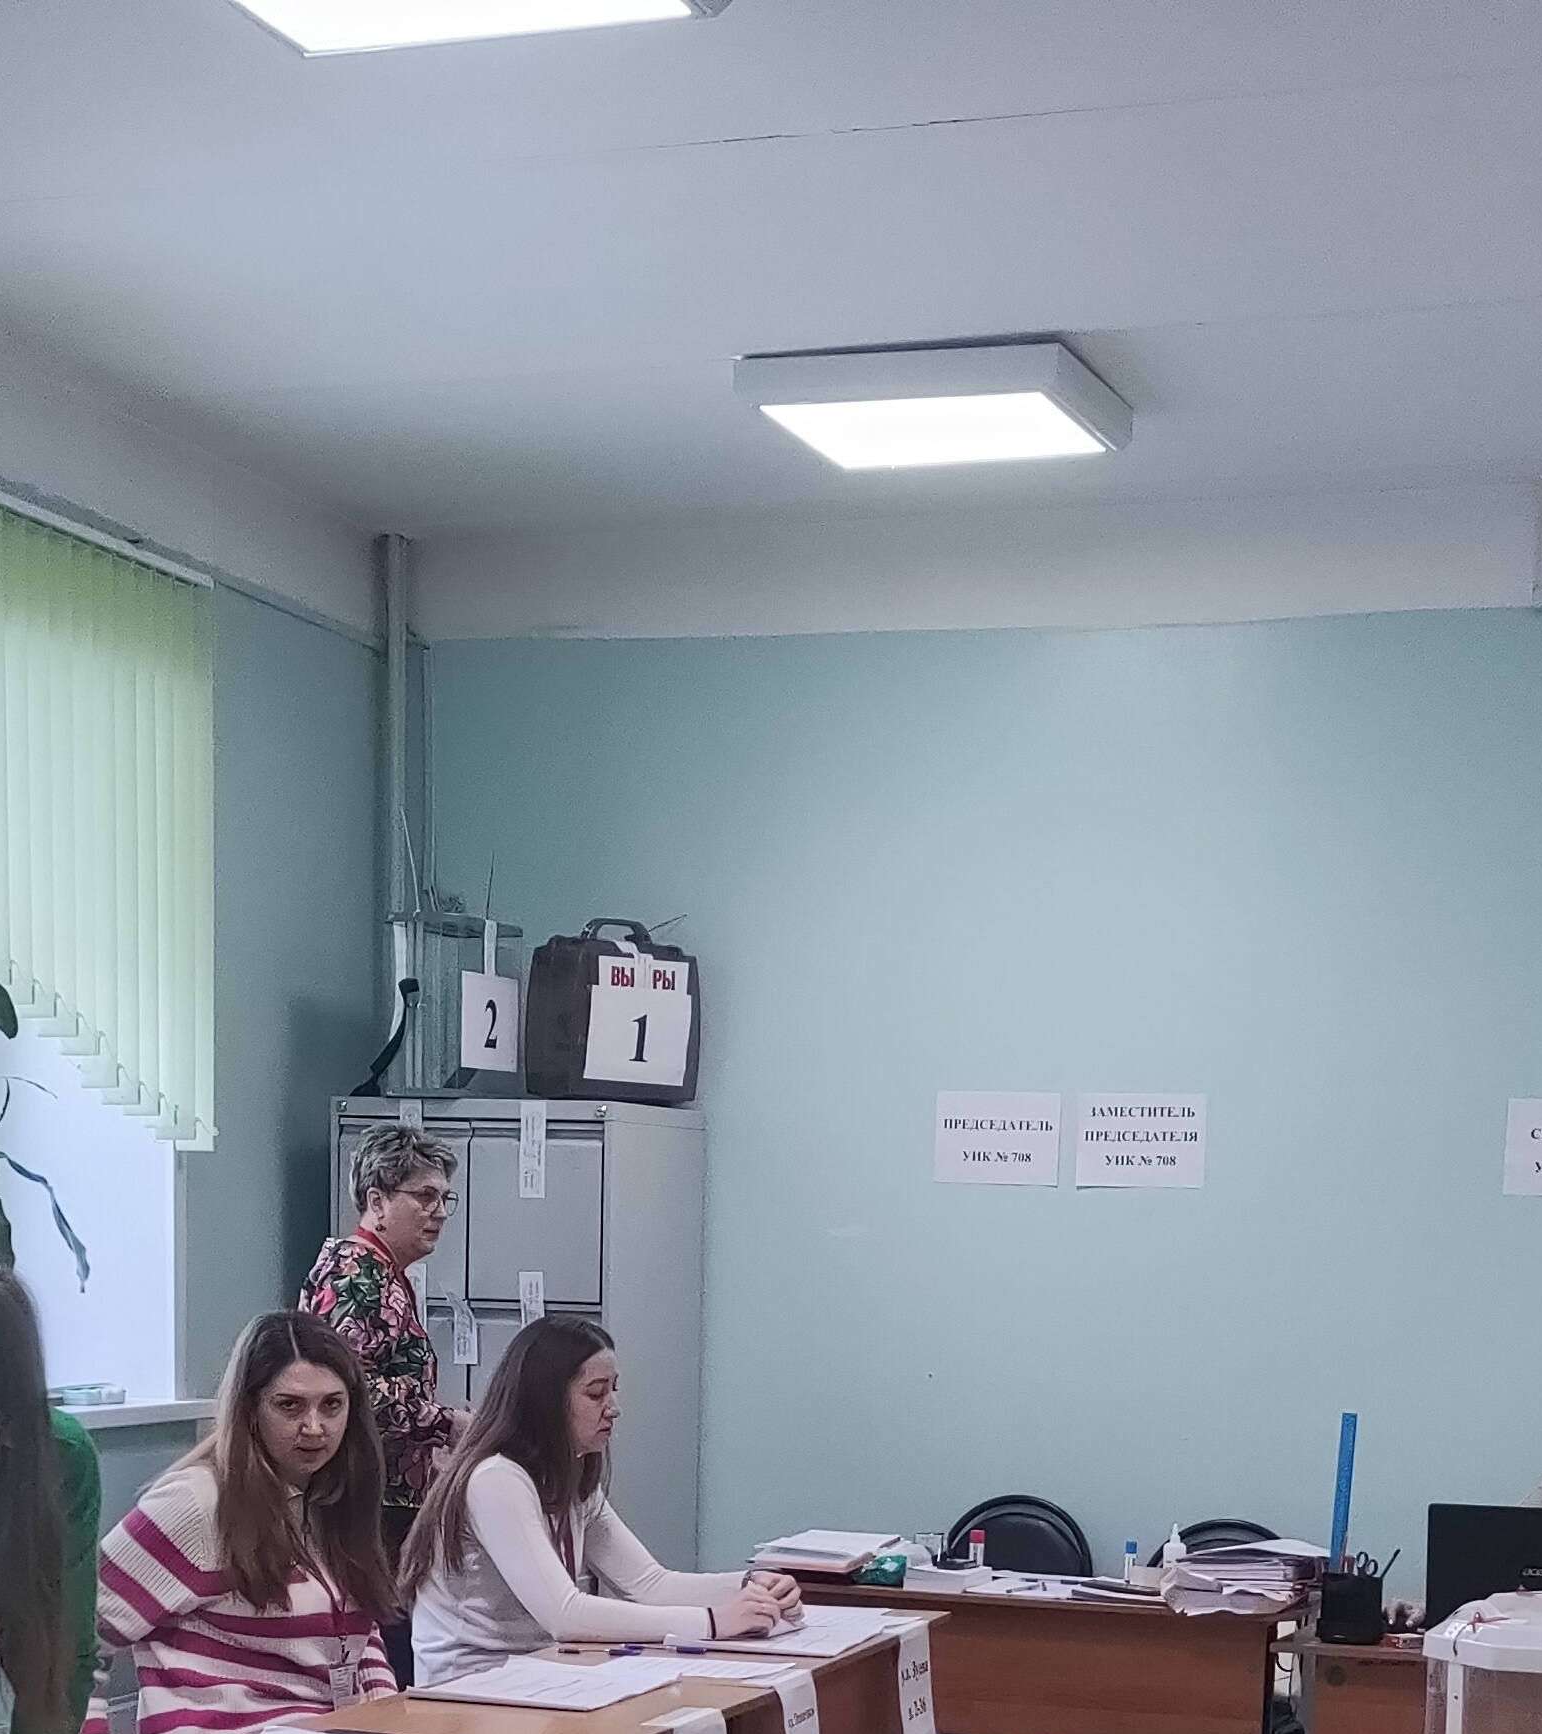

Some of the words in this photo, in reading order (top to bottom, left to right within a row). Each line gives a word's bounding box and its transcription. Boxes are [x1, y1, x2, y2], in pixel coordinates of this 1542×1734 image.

[611, 965, 676, 991] ВЫРЫ
[483, 999, 498, 1049] 2
[629, 1014, 648, 1063] 1
[1090, 1106, 1196, 1118] ЗАМЕСТИТЕЛЬ
[943, 1119, 1053, 1132] ПРЕДСЕДАТЕЛЬ
[1085, 1130, 1199, 1143] ПРЕДСЕДАТЕЛЯ
[962, 1151, 991, 1162] УИК
[994, 1151, 1009, 1163] №
[1011, 1152, 1032, 1163] 708
[1105, 1155, 1135, 1166] УИК
[1138, 1155, 1153, 1166] №
[1156, 1155, 1177, 1166] 708
